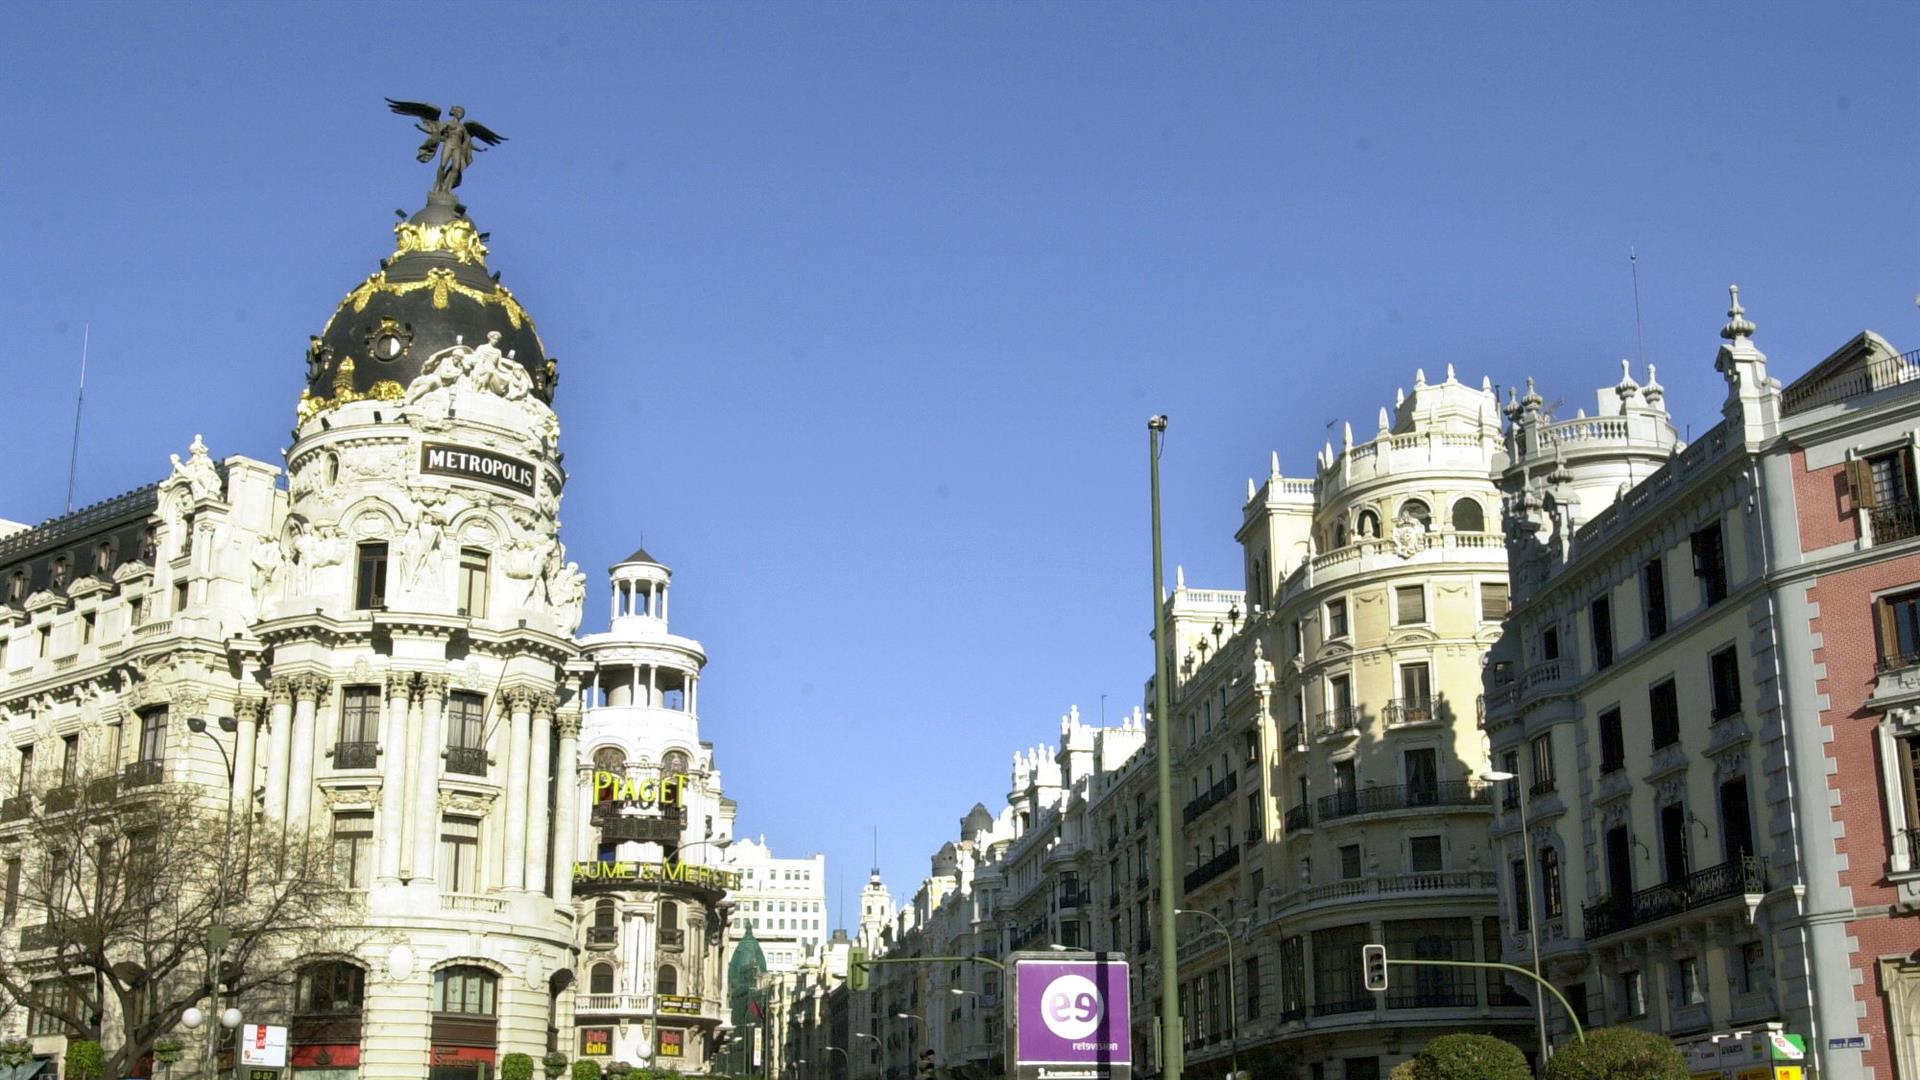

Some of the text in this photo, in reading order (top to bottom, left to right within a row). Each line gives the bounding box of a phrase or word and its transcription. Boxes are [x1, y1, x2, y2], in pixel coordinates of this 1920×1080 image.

[428, 449, 533, 488] METROPOLIS
[593, 771, 690, 808] PIAGET
[641, 863, 655, 879] &
[662, 856, 742, 892] MERCIER
